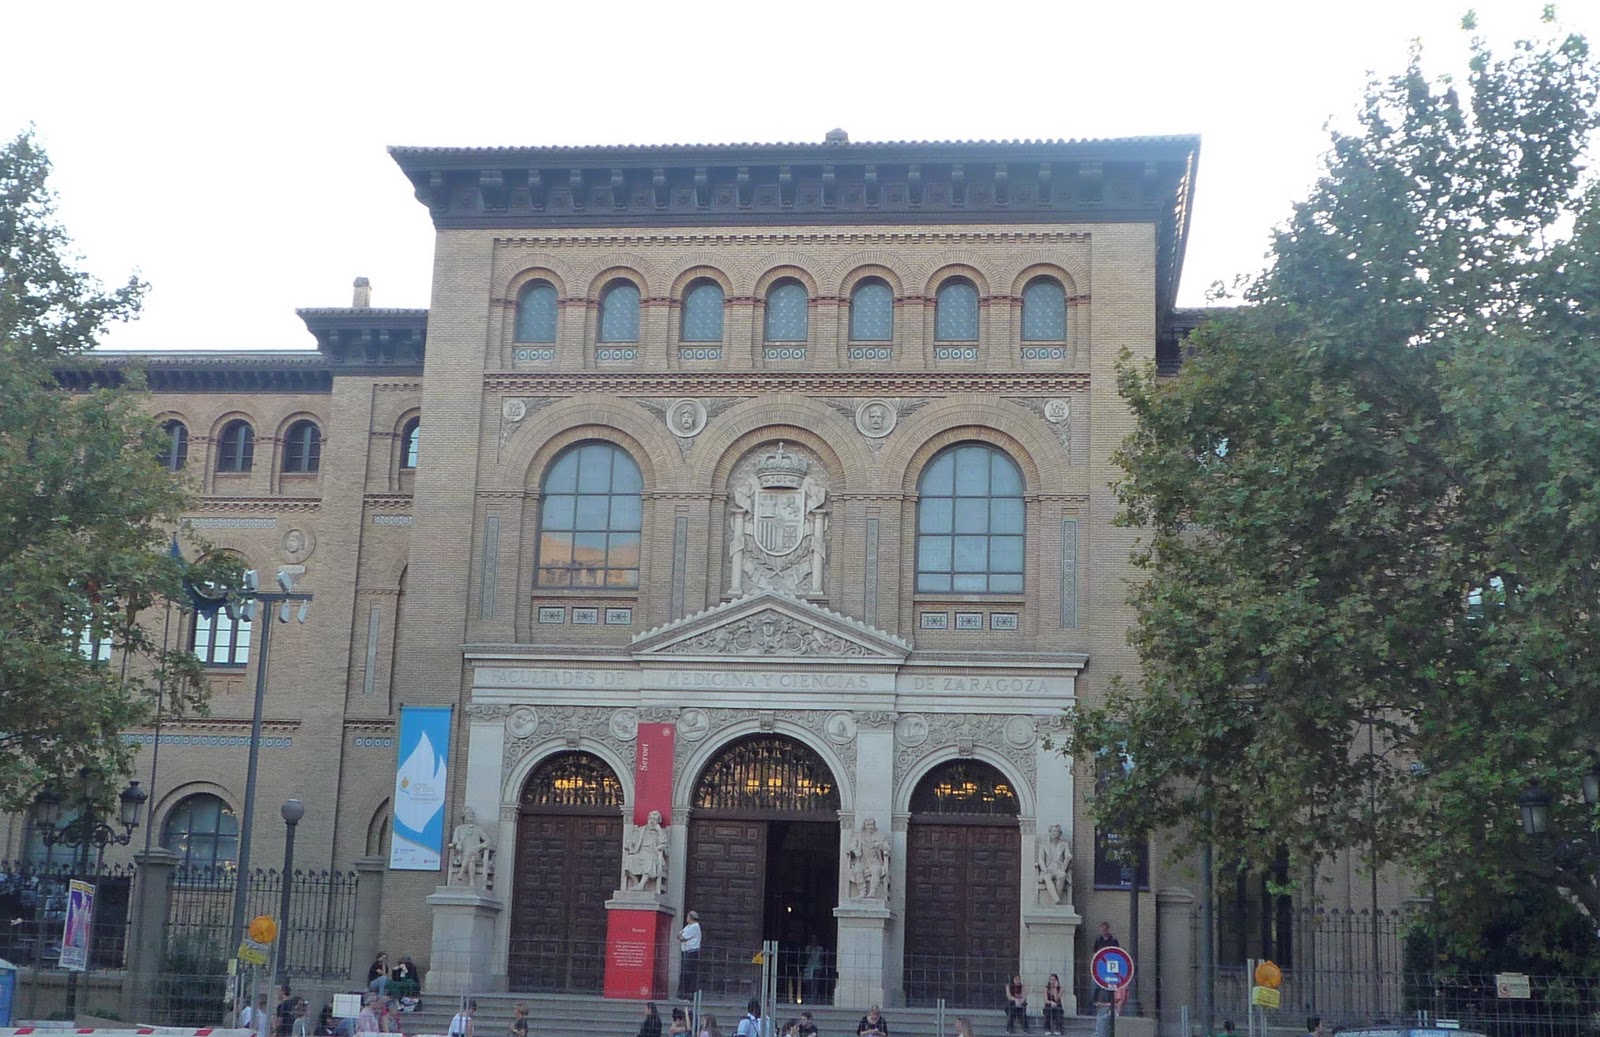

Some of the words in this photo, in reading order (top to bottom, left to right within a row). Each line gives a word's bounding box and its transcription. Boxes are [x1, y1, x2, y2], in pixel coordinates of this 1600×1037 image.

[492, 669, 596, 686] FACULTADES
[604, 671, 626, 687] DE
[665, 671, 757, 688] MEDICINA
[762, 673, 774, 688] Y
[778, 673, 869, 690] CIENCIAS
[913, 676, 936, 691] DE
[942, 676, 1050, 693] ZARAGOZA
[640, 743, 649, 772] Servet
